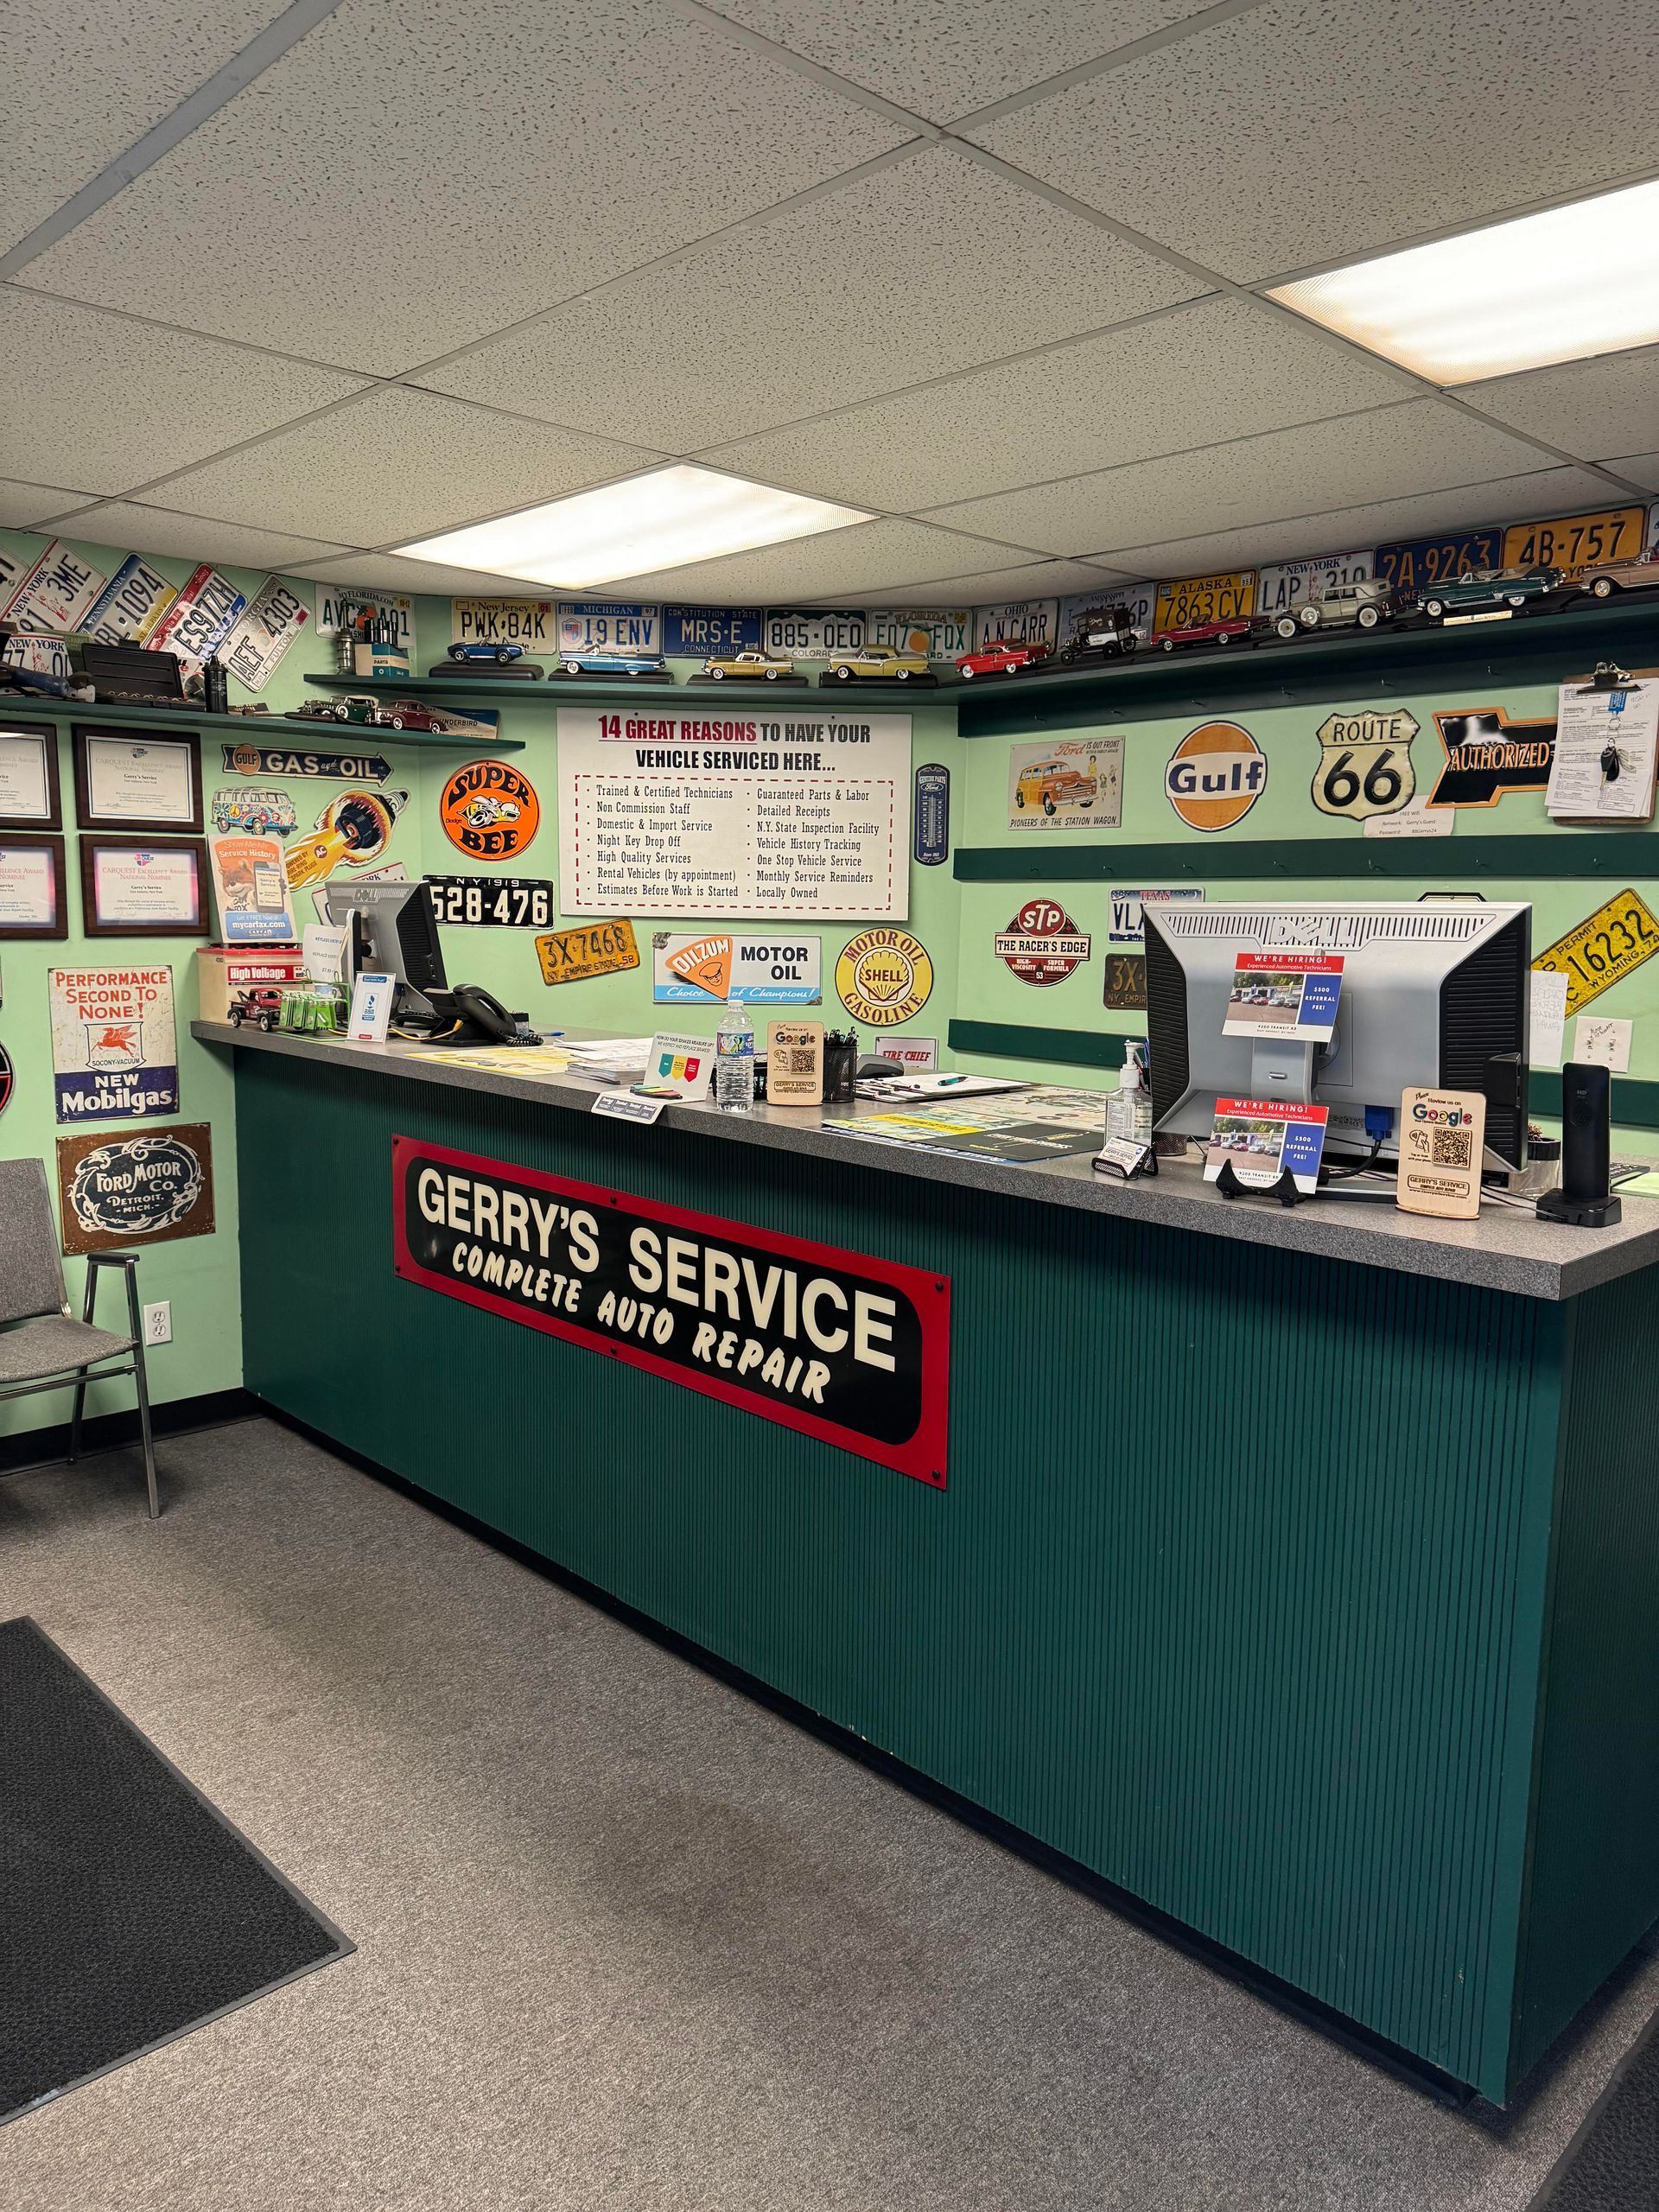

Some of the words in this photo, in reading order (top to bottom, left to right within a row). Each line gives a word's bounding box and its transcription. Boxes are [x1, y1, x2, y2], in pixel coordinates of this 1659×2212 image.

[1519, 521, 1625, 567] 4B-757
[1287, 566, 1310, 575] NEW
[1313, 558, 1341, 570] YORK
[47, 554, 92, 602] 3ME
[1179, 578, 1233, 594] ALASKA
[12, 591, 31, 616] NEW
[29, 568, 49, 594] YORK
[115, 567, 164, 626] 1094
[87, 576, 125, 625] PENNSYLVANIA
[478, 602, 499, 611] New
[502, 603, 530, 613] Jersey
[258, 588, 301, 638] 4303
[582, 605, 633, 614] MICHIGAN
[668, 608, 726, 618] CONSTITUTION
[732, 609, 757, 619] STATE
[1005, 605, 1028, 616] OHIO
[894, 613, 947, 624] FLORIDA
[584, 619, 607, 645] 19
[615, 619, 653, 647] ENV
[269, 632, 293, 664] FULTON
[685, 645, 738, 654] CONNECTICUT
[598, 715, 621, 738] 14
[626, 719, 677, 740] GREAT
[681, 721, 757, 741] REASONS
[760, 723, 780, 741] TO
[785, 723, 824, 742] HAVE
[827, 724, 870, 743] YOUR
[1332, 718, 1402, 742] ROUTE
[1054, 741, 1086, 756] Ford
[1103, 740, 1121, 748] FRONT
[236, 753, 257, 766] GULF
[635, 749, 699, 768] VEHICLE
[702, 751, 779, 770] SERVICED
[783, 753, 836, 771] HERE...
[1450, 742, 1550, 771] AUTHORIZED
[266, 753, 320, 774] GAS
[340, 759, 378, 778] OIL
[1168, 760, 1264, 794] Gulf
[1323, 748, 1402, 807] 66
[448, 766, 531, 810] SUPER
[596, 785, 629, 796] Trained
[633, 785, 640, 796] &
[644, 786, 680, 798] Certified
[683, 787, 733, 799] Technicians
[757, 788, 804, 800] Guaranteed
[809, 789, 831, 800] Parts
[835, 790, 842, 800] &
[846, 790, 869, 801] Labor
[596, 802, 612, 812] Non
[616, 802, 665, 814] Commission
[670, 803, 691, 814] Staff
[757, 804, 791, 817] Detailed
[795, 805, 830, 818] Receipts
[596, 817, 634, 830] Domestic
[639, 819, 645, 829] &
[649, 819, 677, 832] Import
[681, 820, 713, 831] Service
[757, 821, 773, 833] N.Y.
[775, 822, 797, 833] State
[801, 822, 844, 836] Inspection
[849, 823, 880, 836] Facility
[1010, 818, 1038, 828] PIONEERS
[1040, 817, 1048, 827] OF
[1051, 817, 1063, 826] THE
[1065, 817, 1090, 825] STATION
[460, 825, 519, 855] BEE
[597, 834, 620, 848] Night
[625, 836, 640, 848] Key
[645, 836, 664, 849] Drop
[668, 836, 681, 847] Off
[757, 837, 786, 849] Vehicle
[791, 838, 821, 851] History
[823, 839, 861, 852] Tracking
[249, 849, 276, 859] History
[316, 846, 327, 857] AC
[597, 850, 616, 864] High
[620, 852, 652, 865] Quality
[655, 852, 691, 863] Services
[757, 854, 772, 865] One
[776, 855, 794, 868] Stop
[798, 855, 827, 866] Vehicle
[830, 855, 862, 867] Service
[597, 868, 624, 879] Rental
[627, 868, 661, 880] Vehicles
[664, 869, 678, 881] (by
[681, 869, 736, 882] appointment)
[756, 870, 790, 883] Monthly
[794, 871, 826, 882] Service
[830, 872, 874, 883] Reminders
[597, 884, 638, 895] Estimates
[642, 885, 669, 896] Before
[671, 885, 692, 896] Work
[696, 886, 704, 896] is
[708, 886, 739, 897] Started
[756, 887, 786, 899] Locally
[791, 887, 818, 899] Owned
[1139, 890, 1171, 901] TEXAS
[430, 886, 548, 925] 528-476
[232, 921, 286, 930] mycarfax.com
[1022, 904, 1060, 931] STP
[1269, 917, 1355, 945] DELL
[1556, 922, 1597, 955] PERMIT
[843, 930, 899, 963] MOTOR
[899, 937, 925, 966] OIL
[997, 941, 1015, 952] THE
[1018, 941, 1057, 952] RACER'S
[1060, 942, 1087, 953] EDGE
[1567, 909, 1654, 982] 16232
[671, 938, 730, 974] OILZUM
[741, 946, 808, 962] MOTOR
[230, 968, 251, 980] High
[251, 968, 286, 980] Voltage
[565, 962, 592, 976] EMPIRE
[771, 964, 802, 981] OIL
[865, 969, 903, 982] SHELL
[1587, 950, 1639, 989] WYOMING
[55, 971, 168, 988] PERFORMANCE
[66, 988, 131, 1004] SECOND
[138, 986, 157, 1001] TO
[666, 987, 705, 997] Choice
[731, 987, 744, 997] of
[749, 988, 815, 1000] Champions!
[843, 992, 925, 1023] GASOLINE
[775, 1031, 816, 1046] Google
[92, 1057, 140, 1067] SOCONY-VACUUM
[881, 1050, 904, 1062] FIRE
[904, 1051, 931, 1062] CHIEF
[94, 1073, 139, 1089] NEW
[60, 1089, 173, 1115] Mobilgas
[1268, 1104, 1308, 1113] HIRING!
[1413, 1103, 1472, 1127] Google
[96, 1173, 133, 1192] FORD
[130, 1162, 181, 1187] MOTOR
[1410, 1176, 1438, 1185] GERRY'S
[1439, 1180, 1467, 1189] SERVICE
[149, 1180, 178, 1192] CO.
[418, 1167, 600, 1273] GERRY'S
[629, 1226, 896, 1373] SERVICE
[452, 1242, 582, 1313] COMPLETE
[597, 1290, 675, 1345] AUTO
[692, 1321, 831, 1405] REPAIR
